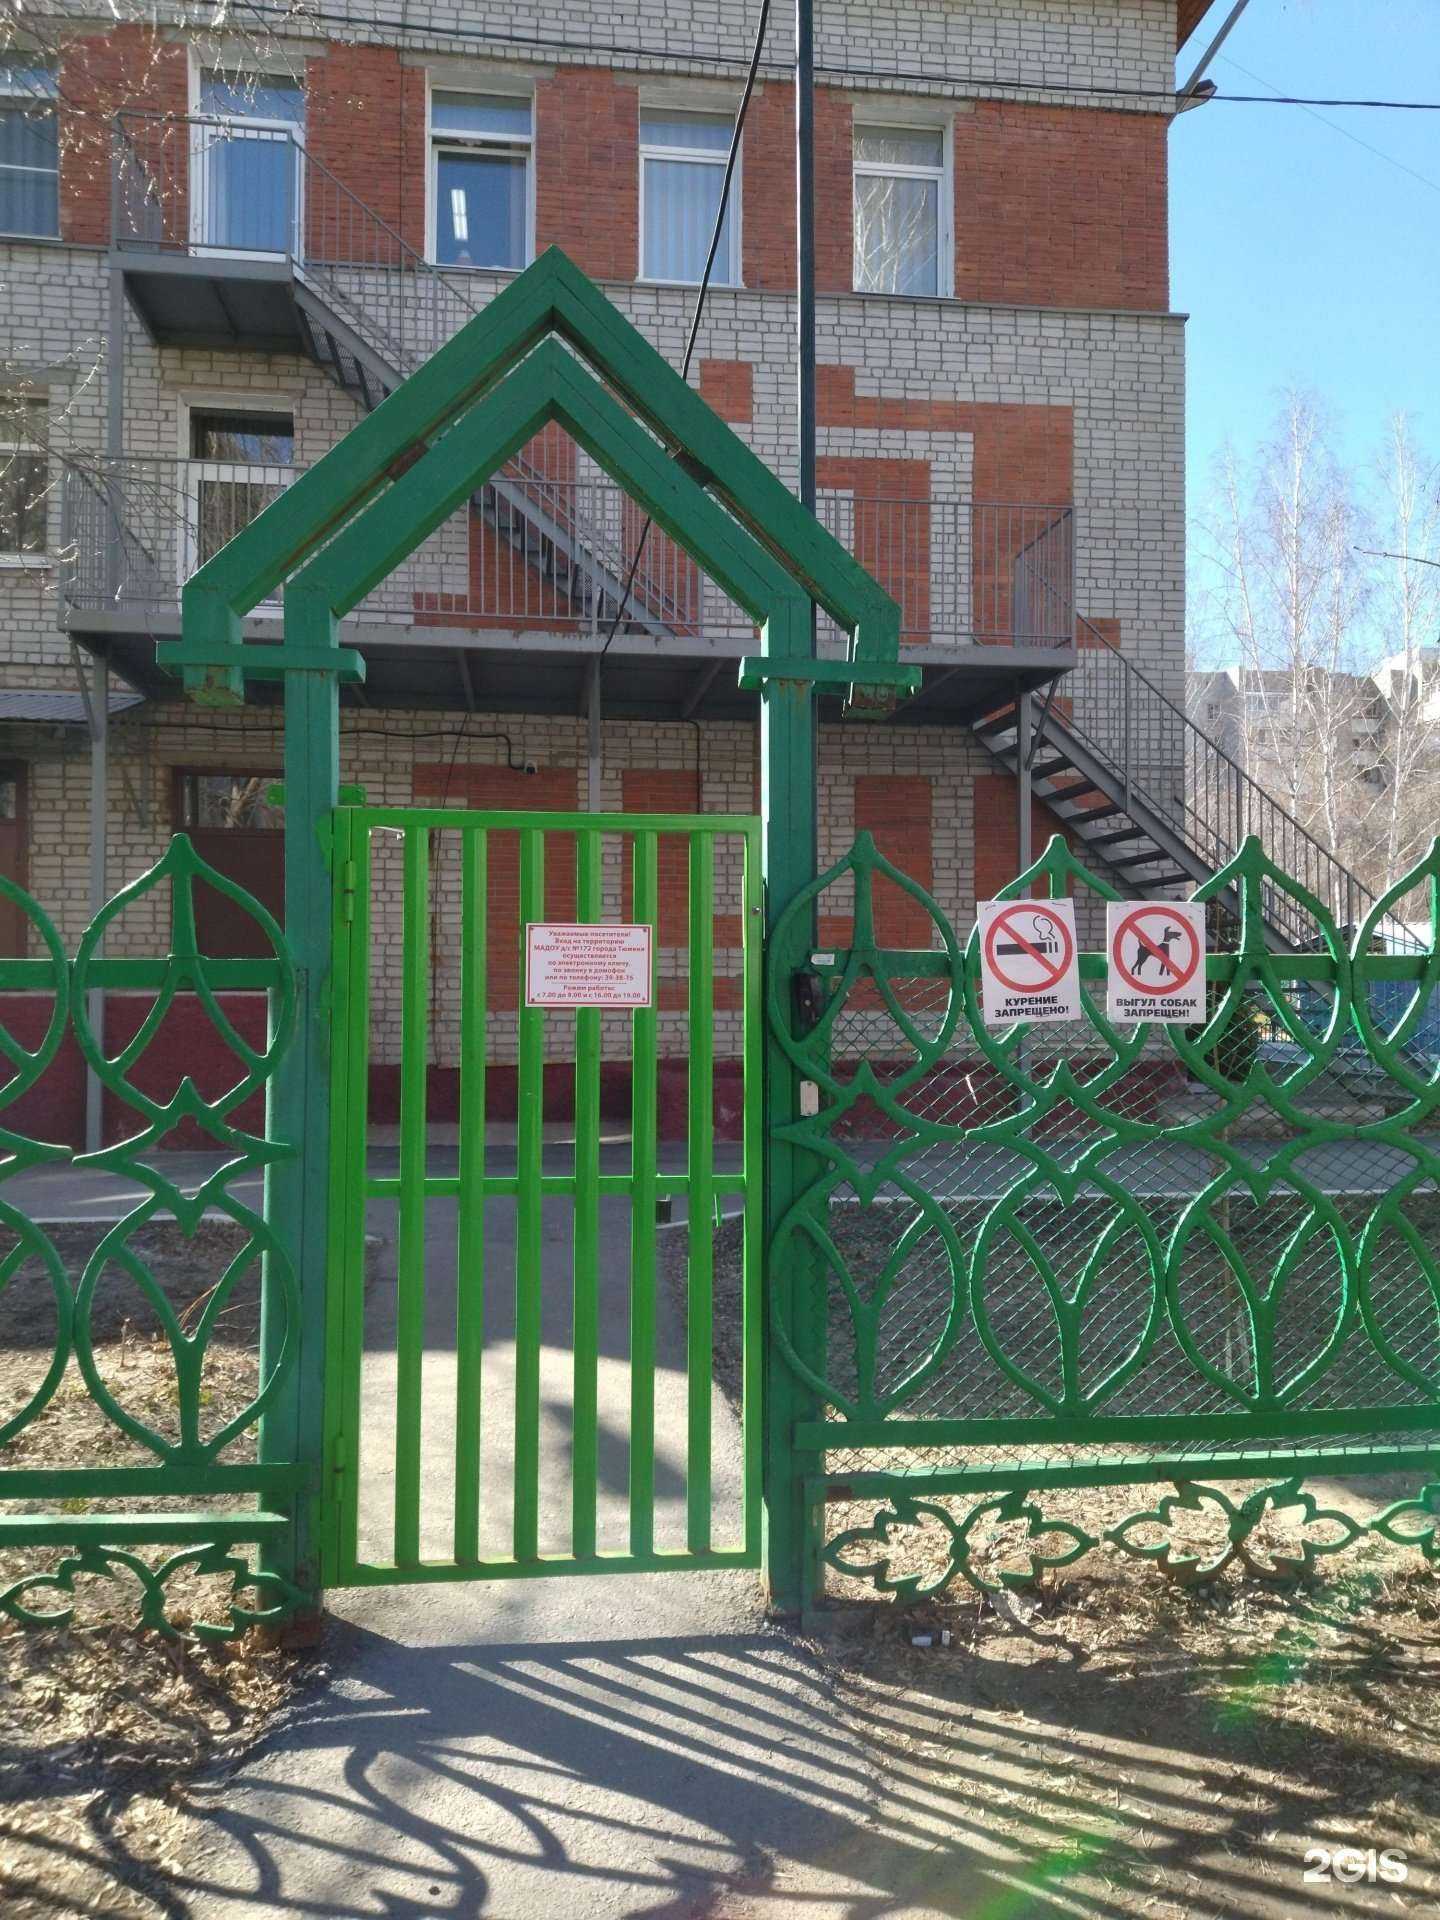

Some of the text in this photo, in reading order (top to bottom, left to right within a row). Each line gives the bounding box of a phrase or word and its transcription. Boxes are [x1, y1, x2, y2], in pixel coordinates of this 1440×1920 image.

[1005, 996, 1058, 1006] КУРЕНИЕ
[1116, 998, 1197, 1007] ВЫГУЛ СОБАК
[995, 1006, 1069, 1018] ЗАПРЕЩЕНО!
[1124, 1009, 1190, 1018] ЗАПРЕЩЕН!
